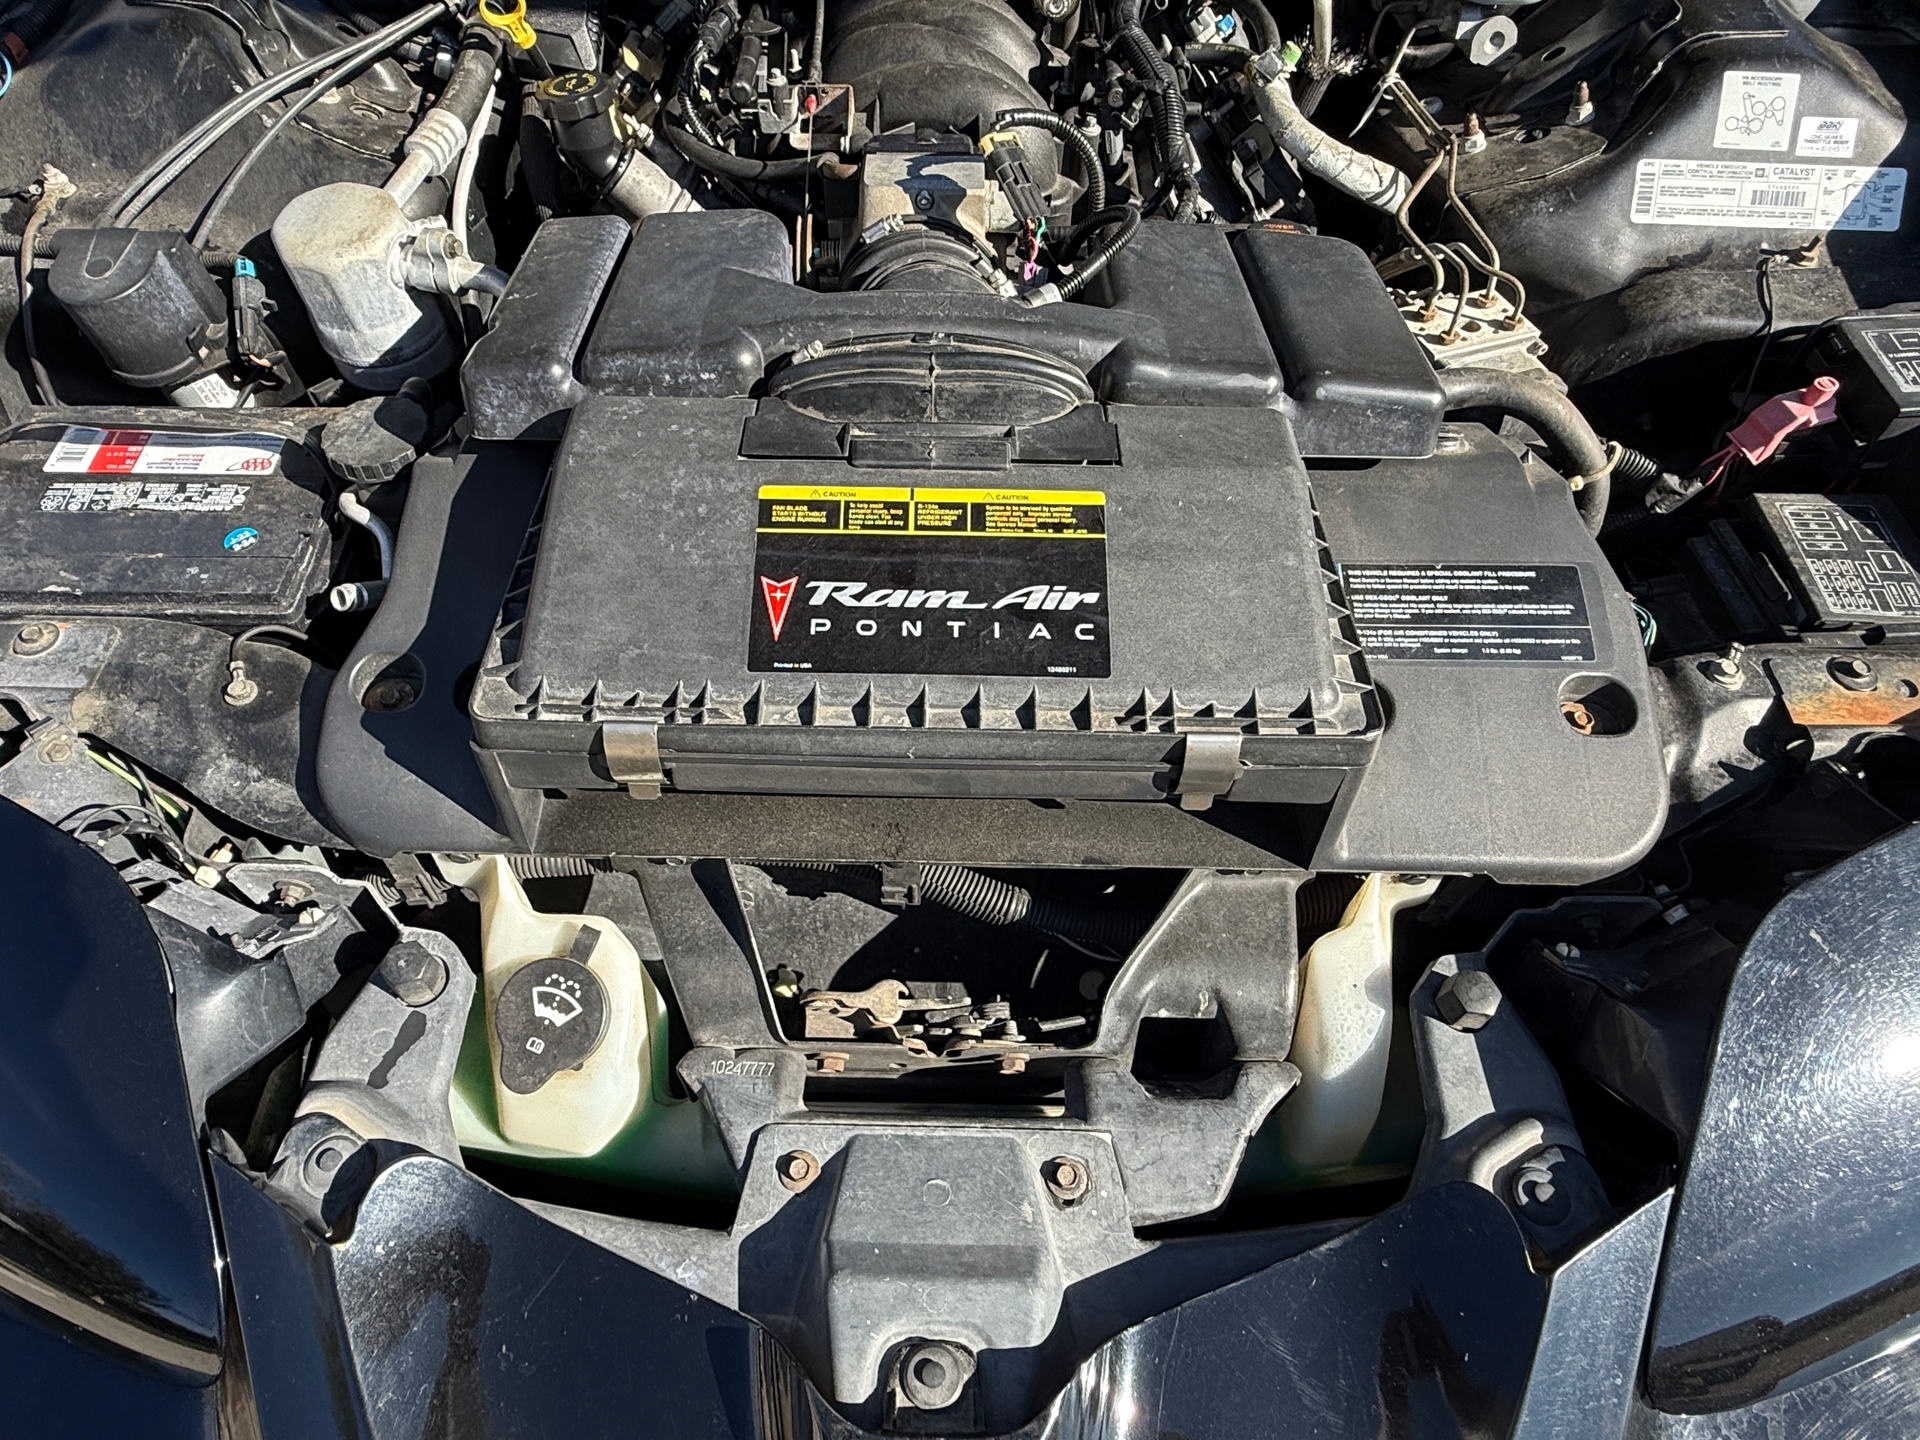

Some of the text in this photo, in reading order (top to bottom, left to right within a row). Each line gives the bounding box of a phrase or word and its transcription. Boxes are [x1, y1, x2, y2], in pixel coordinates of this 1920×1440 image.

[1773, 167, 1816, 176] CATALYST
[241, 458, 270, 471] AAA
[806, 581, 1100, 610] Ram Air
[810, 618, 1095, 640] PONTIAC
[711, 1060, 775, 1076] 10247777
